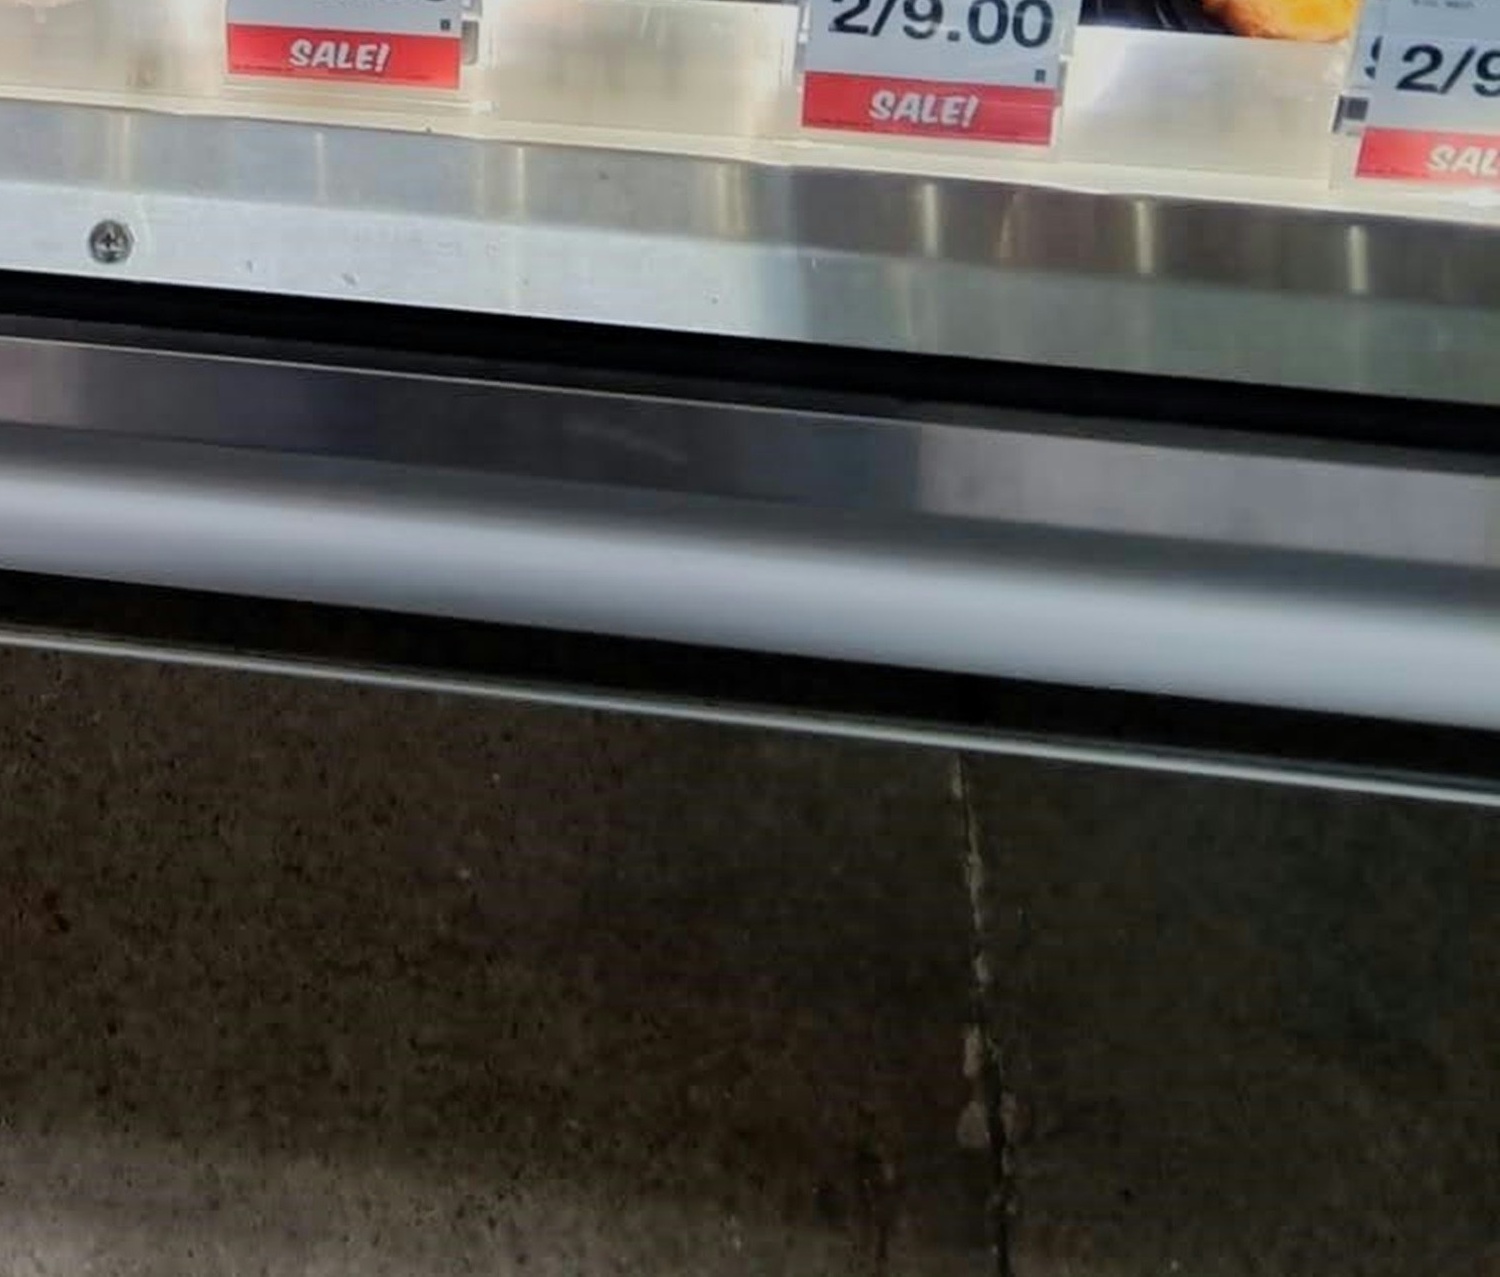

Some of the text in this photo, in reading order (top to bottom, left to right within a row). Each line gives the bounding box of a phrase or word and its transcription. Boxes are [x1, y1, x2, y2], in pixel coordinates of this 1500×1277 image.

[289, 39, 391, 73] SALE!
[868, 91, 979, 127] SALE!
[1428, 144, 1500, 176] SAL
